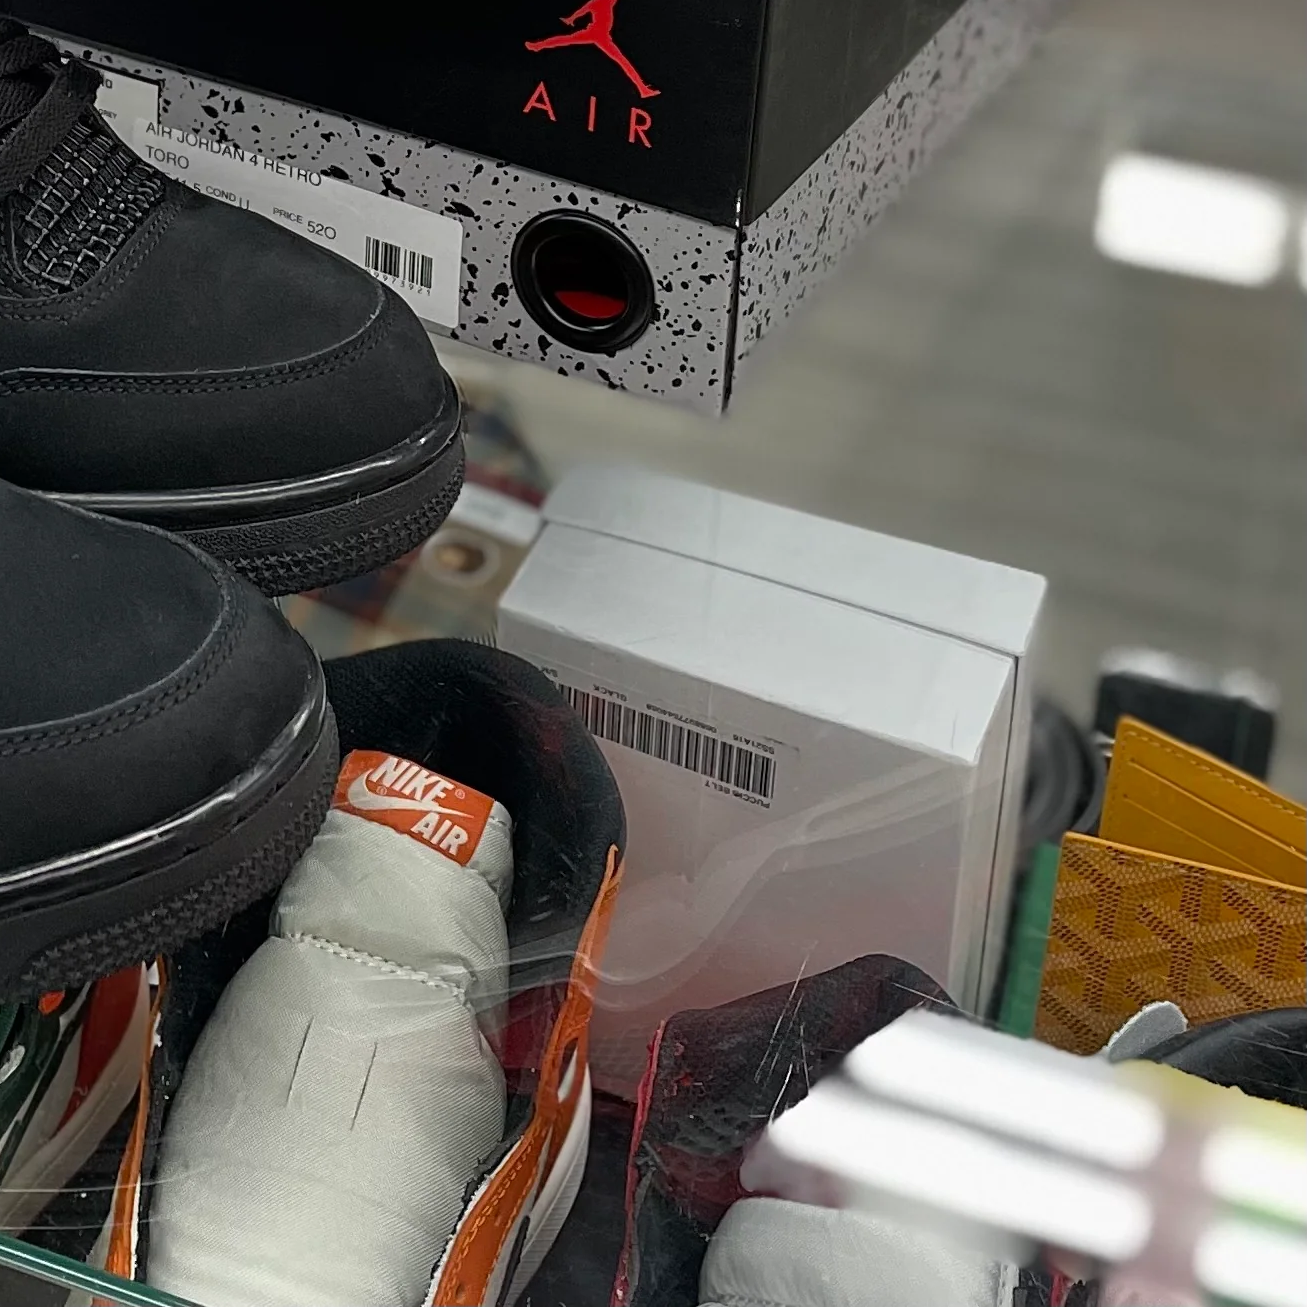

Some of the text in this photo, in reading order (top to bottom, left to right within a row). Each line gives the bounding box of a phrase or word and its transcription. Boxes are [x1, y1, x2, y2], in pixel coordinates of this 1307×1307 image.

[522, 81, 652, 148] AIR
[146, 122, 322, 187] AIR JORDAN 4 RETRO
[146, 145, 190, 170] TORO
[205, 185, 236, 203] COND
[272, 207, 303, 225] PRICE
[307, 220, 337, 240] 520
[368, 756, 455, 806] NIKE
[410, 811, 469, 856] AIR
